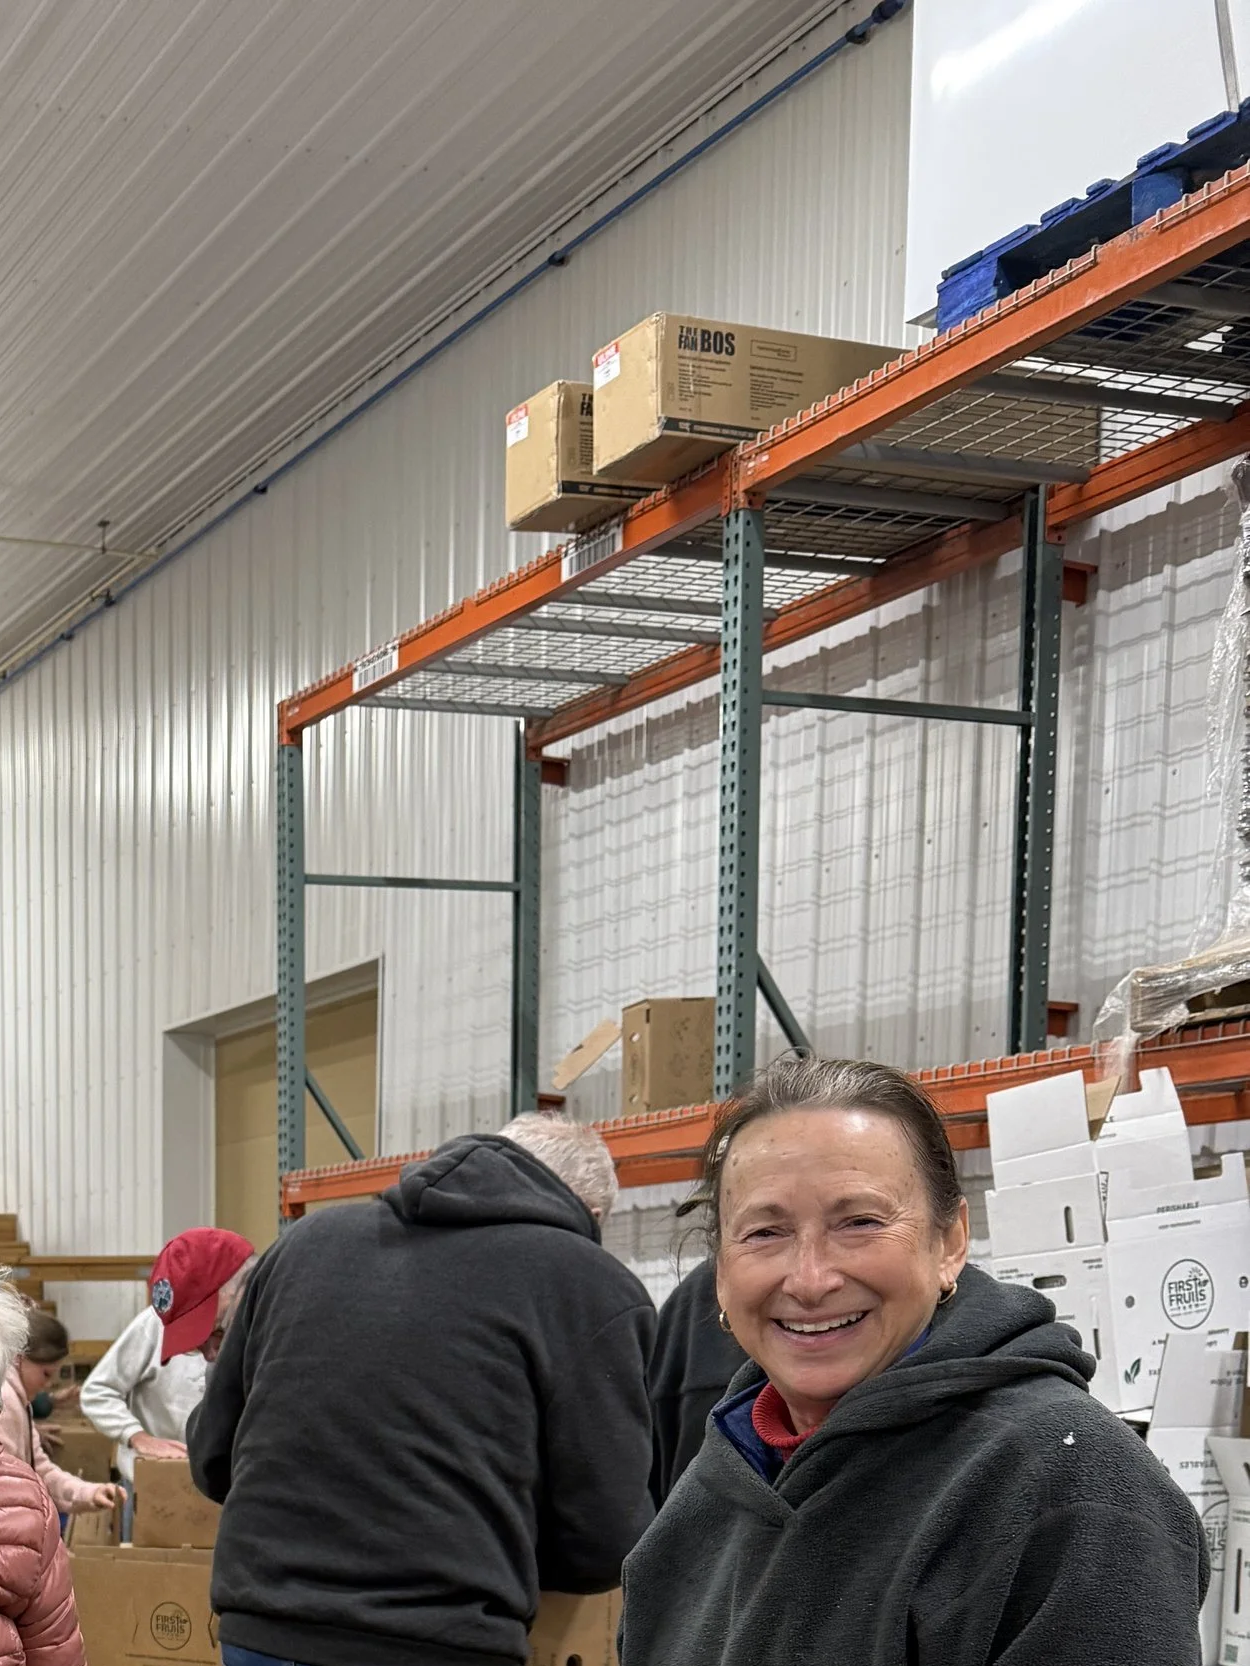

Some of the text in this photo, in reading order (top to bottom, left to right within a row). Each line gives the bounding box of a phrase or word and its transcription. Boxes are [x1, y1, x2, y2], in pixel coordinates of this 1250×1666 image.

[678, 335, 698, 351] FAN
[700, 329, 736, 356] BOS
[1168, 1276, 1201, 1293] FIRST
